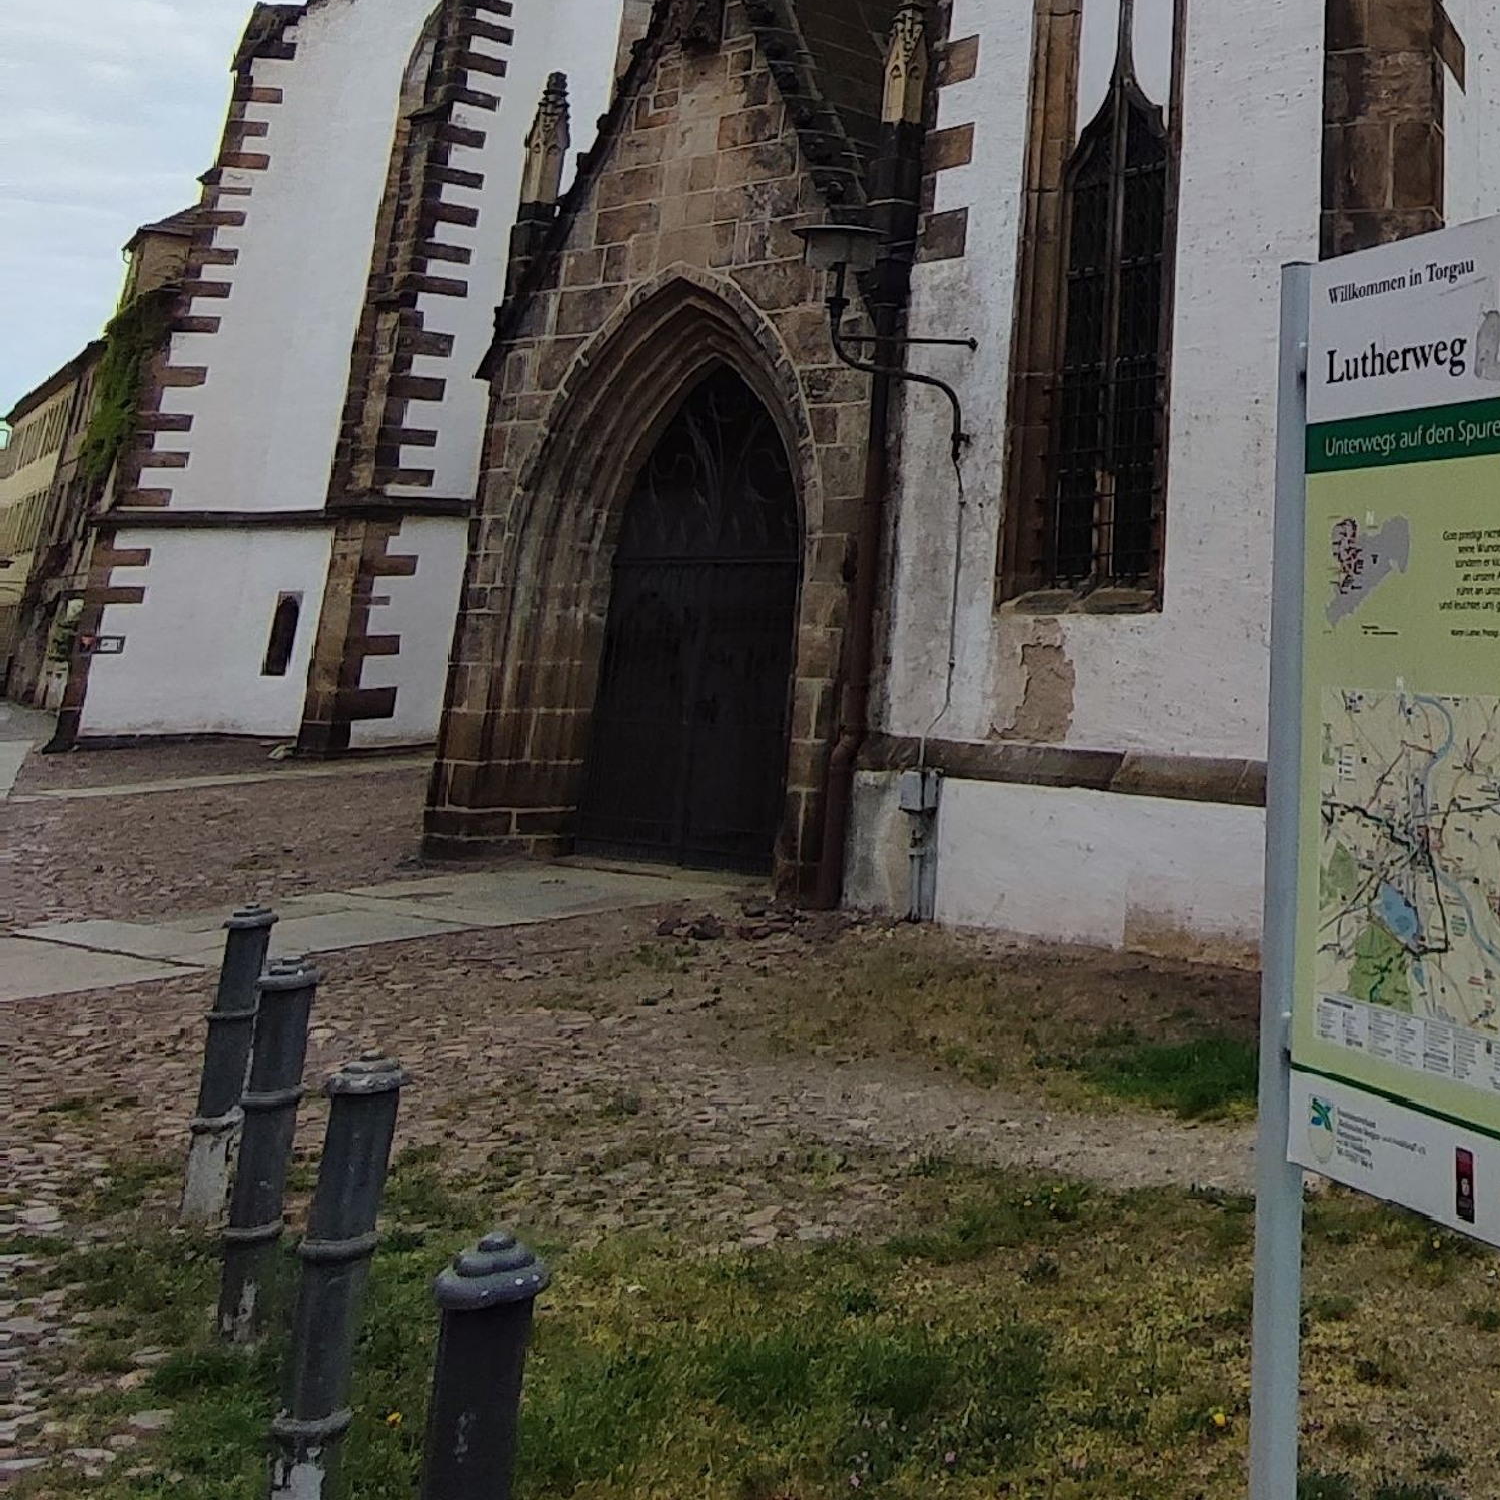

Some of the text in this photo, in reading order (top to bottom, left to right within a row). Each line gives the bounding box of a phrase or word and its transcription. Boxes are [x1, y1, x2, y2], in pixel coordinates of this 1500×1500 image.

[1328, 259, 1475, 304] Willkommen in Torgau
[1326, 337, 1467, 384] Lutherweg
[1325, 432, 1396, 457] Unterwegs
[1400, 424, 1424, 448] auf
[1426, 423, 1455, 445] den
